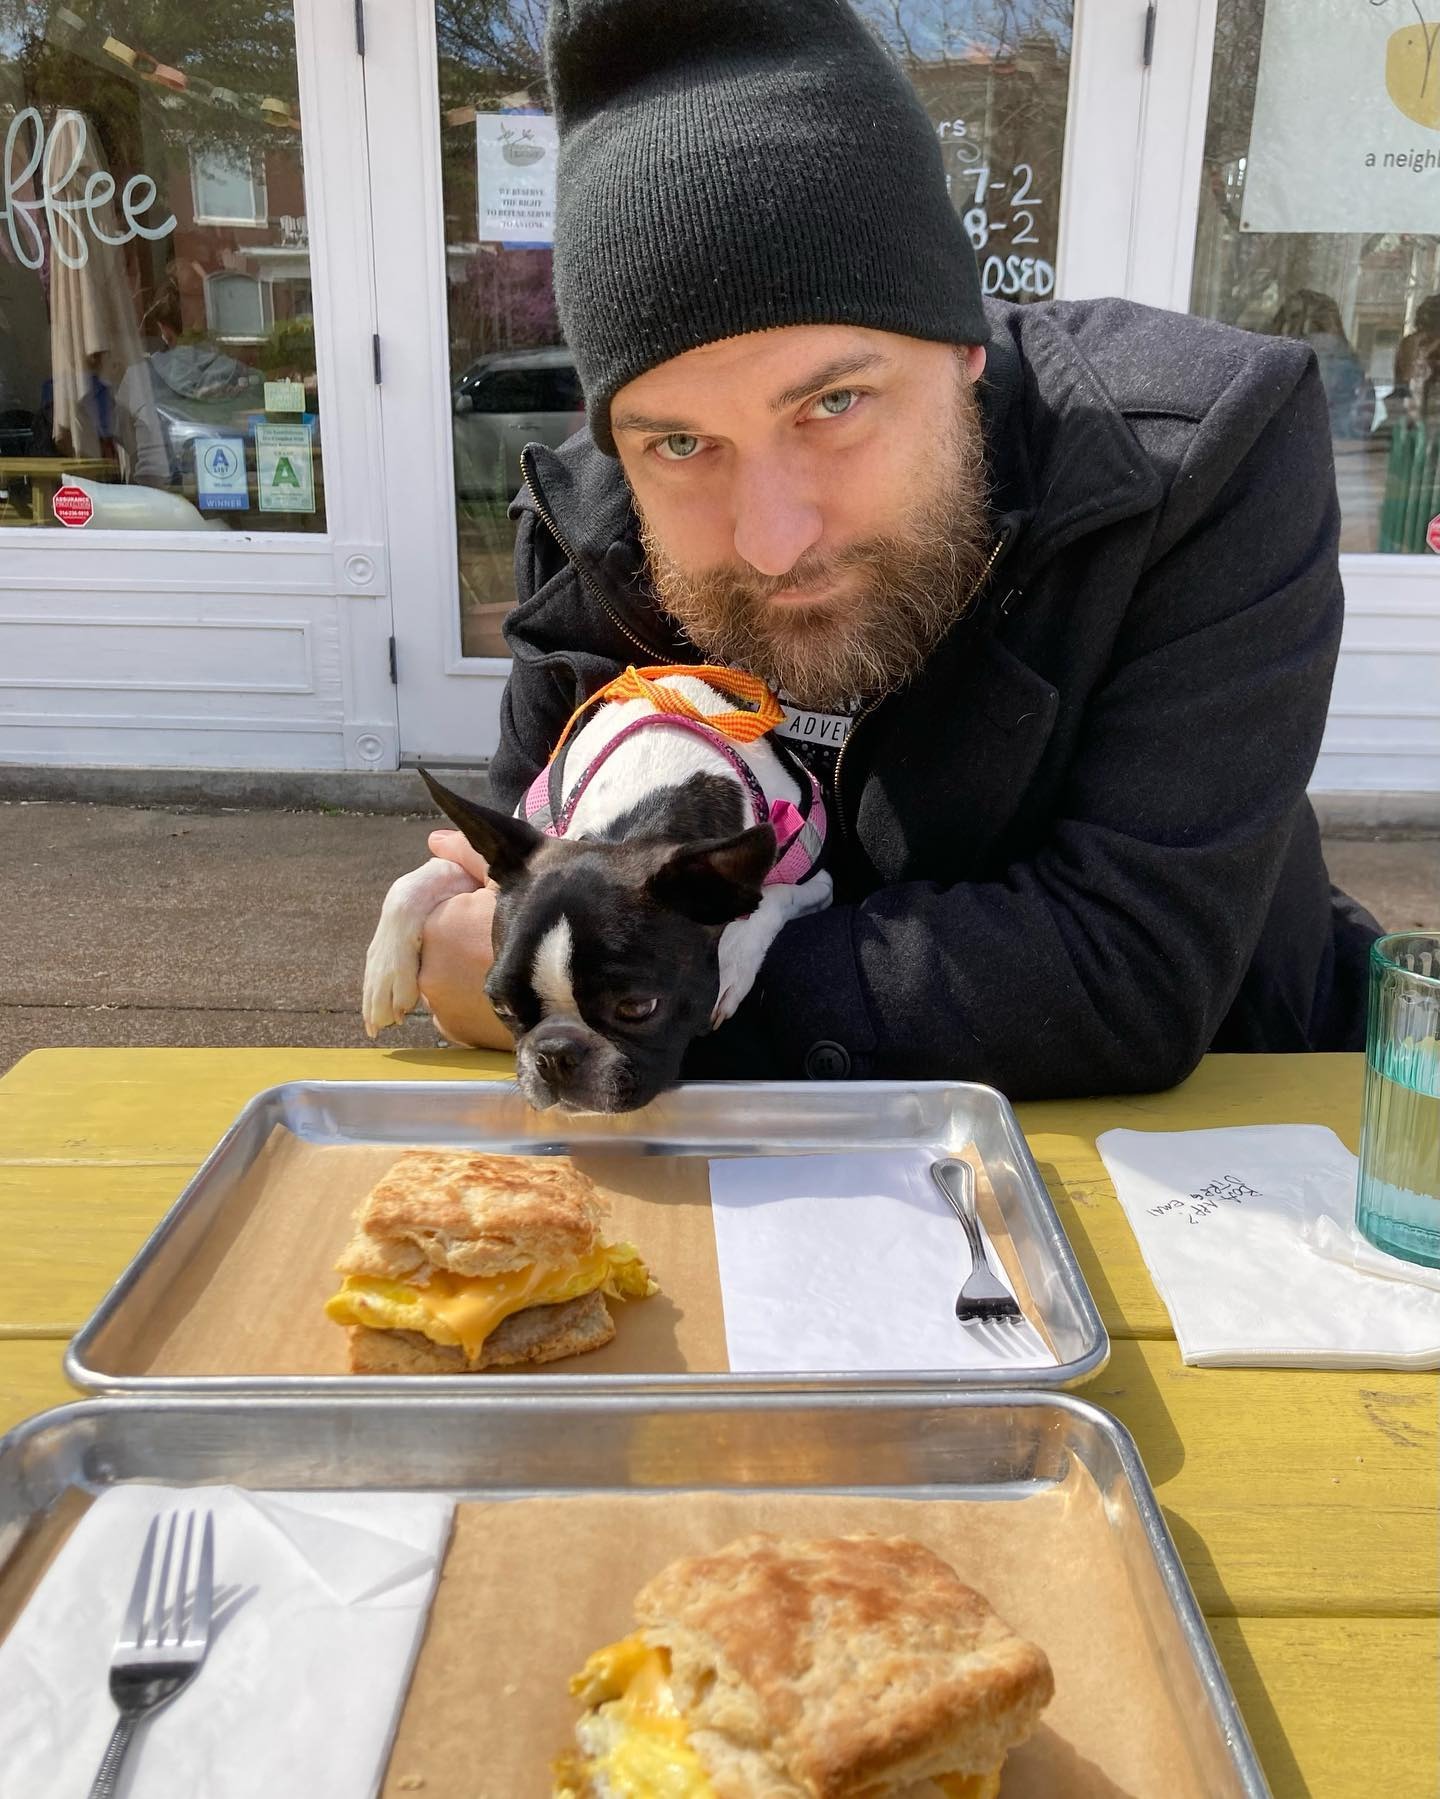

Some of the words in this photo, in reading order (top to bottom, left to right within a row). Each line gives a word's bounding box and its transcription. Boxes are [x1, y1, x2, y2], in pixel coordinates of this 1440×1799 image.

[937, 119, 967, 137] rs
[1365, 153, 1376, 167] a
[0, 107, 178, 270] ffee
[512, 188, 544, 197] RESERVE
[963, 164, 1043, 206] 7-2
[503, 199, 515, 207] THE
[519, 199, 541, 208] RIGHT
[487, 208, 497, 217] TO
[498, 209, 525, 218] REFUSE
[503, 221, 513, 229] TO
[515, 221, 544, 229] ANYONE
[982, 255, 1055, 296] OSED
[213, 448, 229, 467] A
[272, 457, 300, 487] A
[206, 499, 243, 508] WINNER
